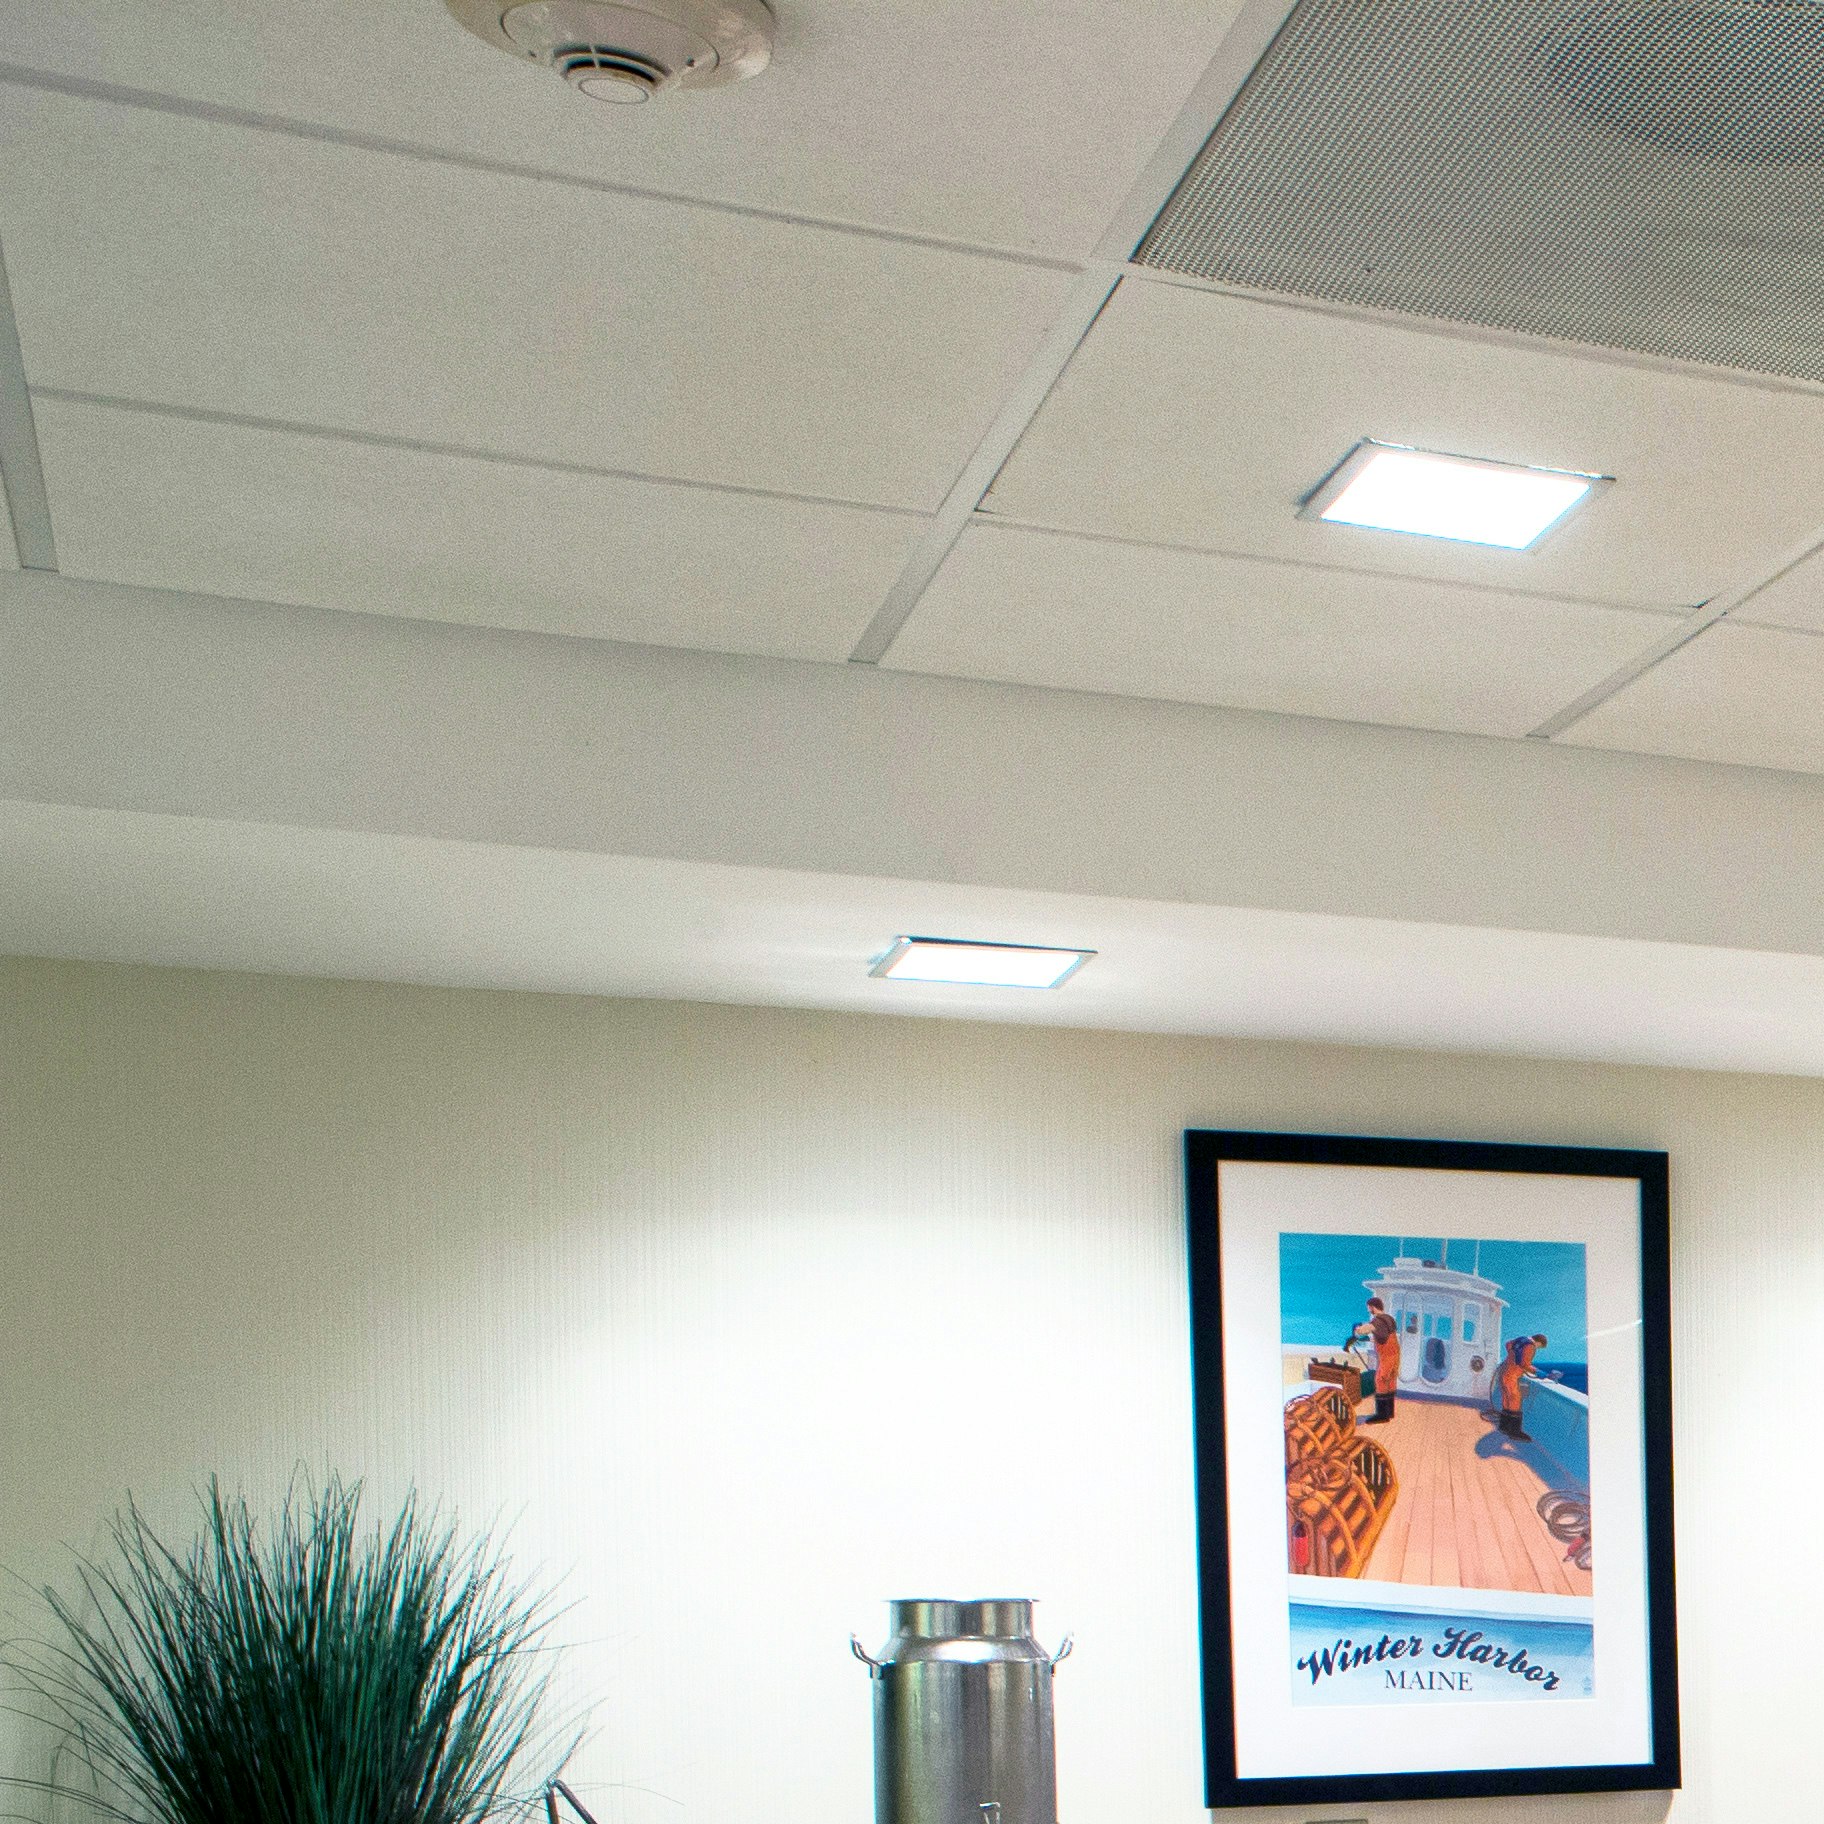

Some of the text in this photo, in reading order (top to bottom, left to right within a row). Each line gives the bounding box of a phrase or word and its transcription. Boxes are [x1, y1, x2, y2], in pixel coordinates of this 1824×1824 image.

[1297, 1627, 1561, 1690] Winter Harbor
[1384, 1669, 1473, 1692] MAINE
